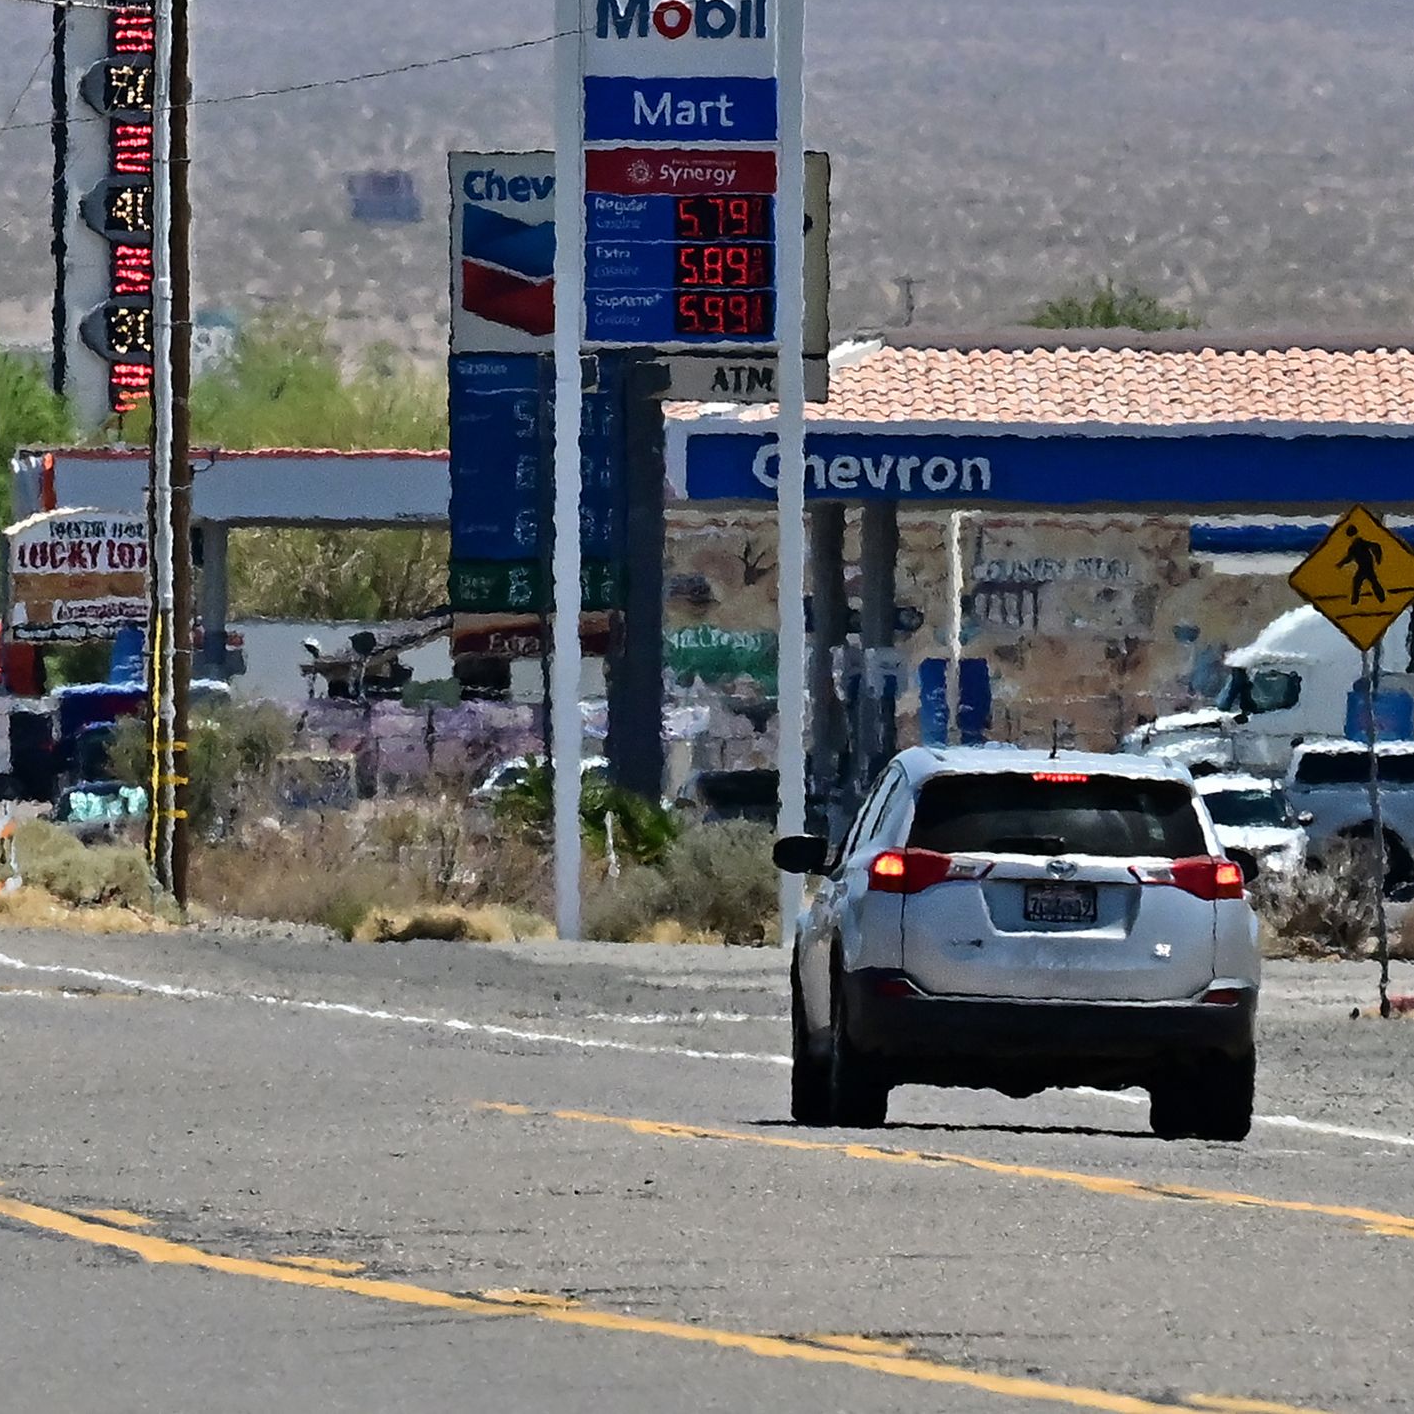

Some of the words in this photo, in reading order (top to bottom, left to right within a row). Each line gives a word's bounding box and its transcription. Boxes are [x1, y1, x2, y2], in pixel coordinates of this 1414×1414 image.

[633, 90, 735, 127] Mart
[658, 163, 737, 186] Synergy
[711, 366, 774, 394] ATM
[18, 540, 102, 570] LUCKY
